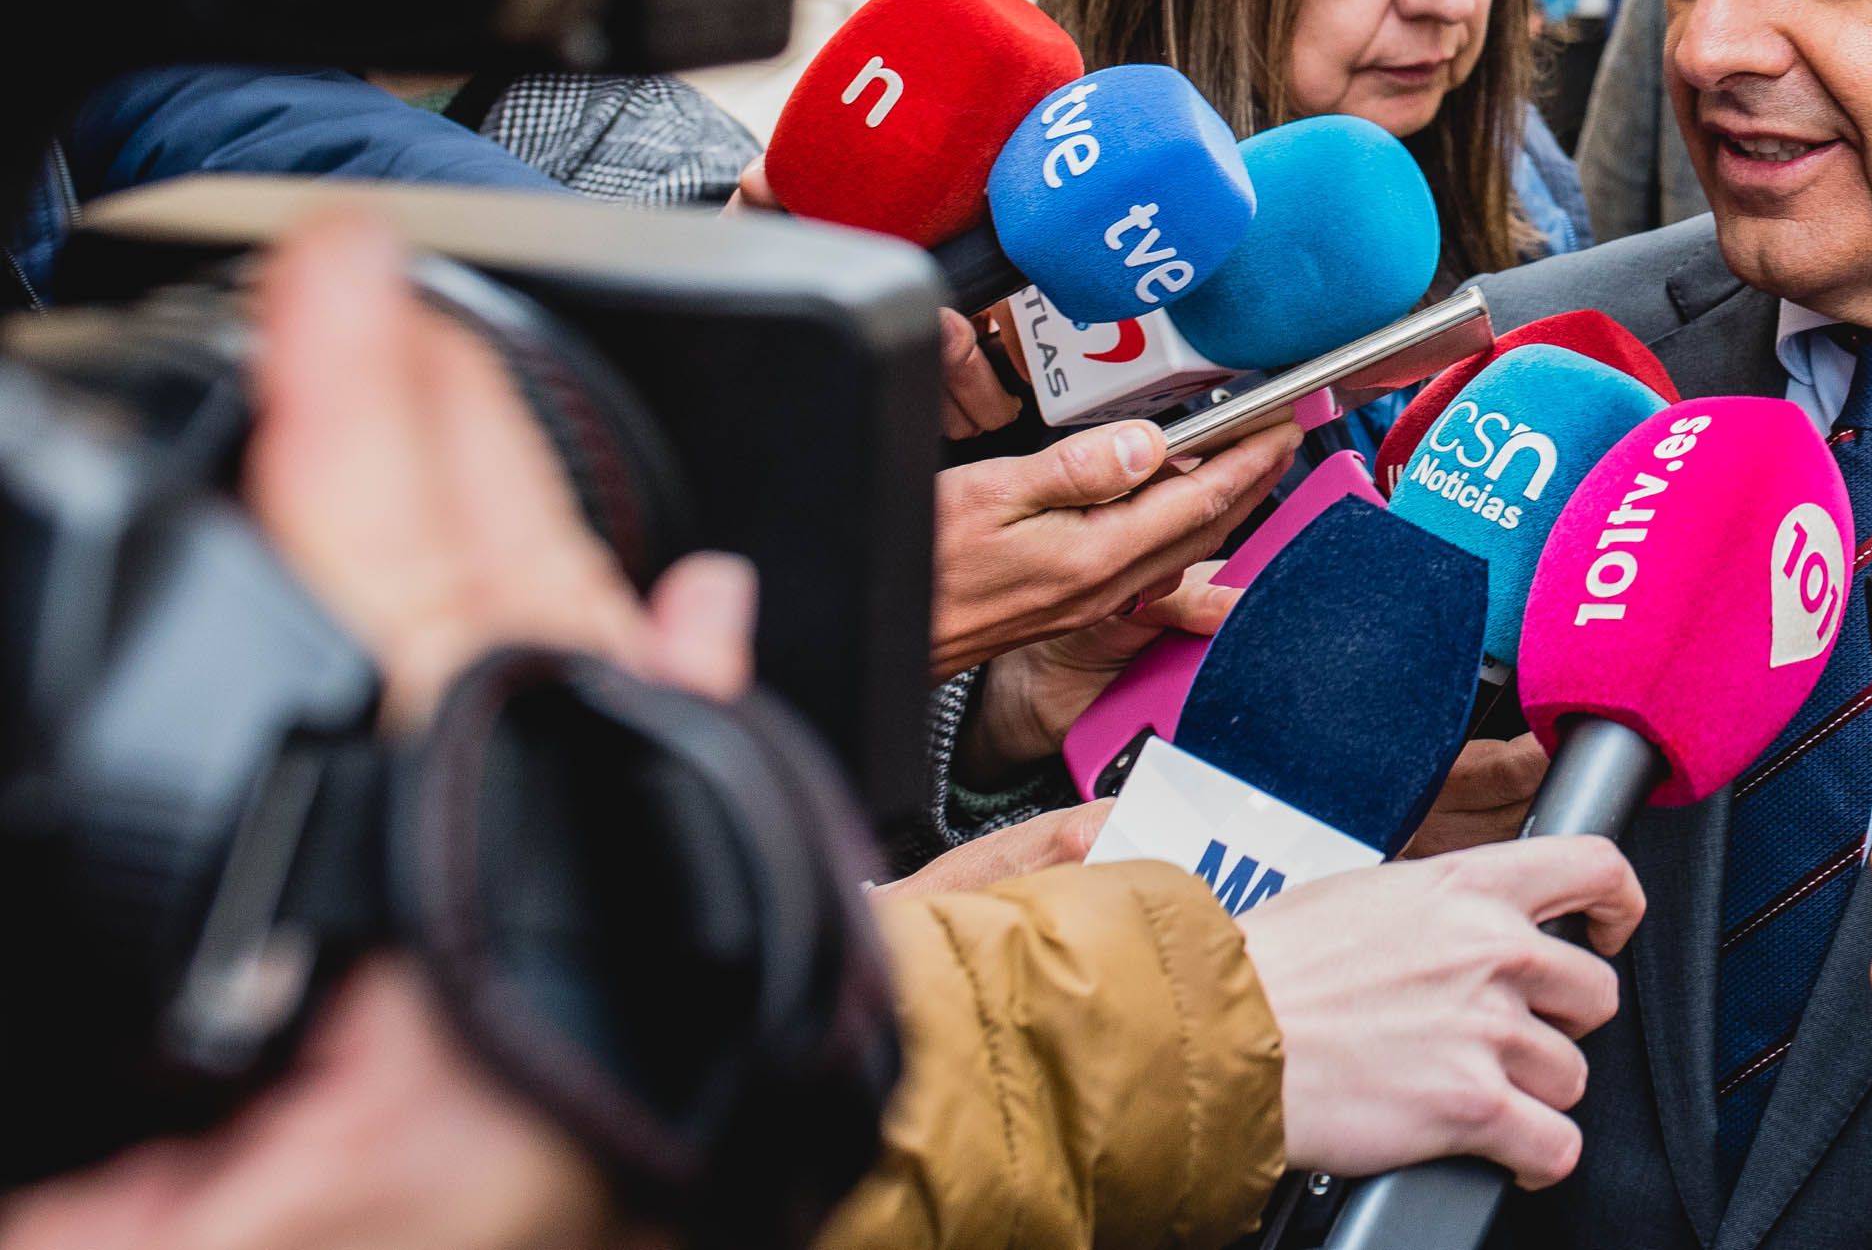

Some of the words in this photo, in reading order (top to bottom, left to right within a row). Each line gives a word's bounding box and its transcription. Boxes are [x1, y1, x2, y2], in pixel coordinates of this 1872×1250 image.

[841, 55, 904, 128] n
[1041, 83, 1100, 189] tve
[1104, 203, 1195, 304] tve
[1021, 286, 1070, 398] TLAS
[1410, 454, 1523, 530] Noticias
[1574, 415, 1712, 626] 101tv.es
[1783, 521, 1839, 641] 101
